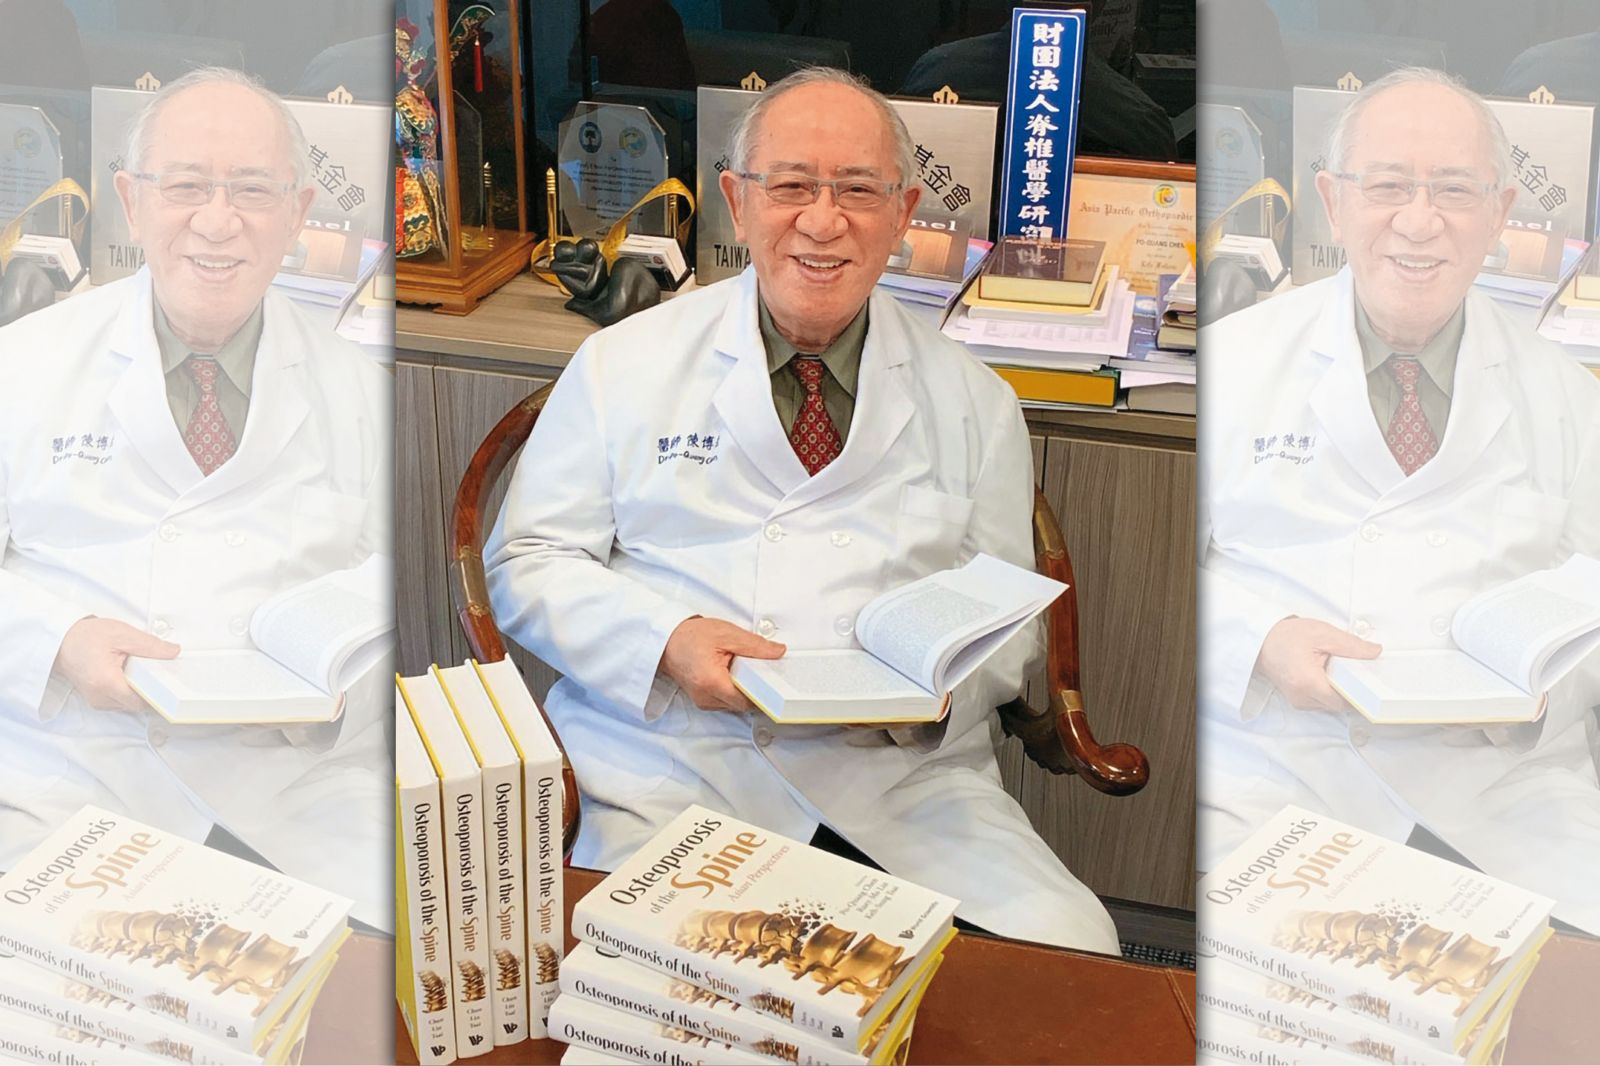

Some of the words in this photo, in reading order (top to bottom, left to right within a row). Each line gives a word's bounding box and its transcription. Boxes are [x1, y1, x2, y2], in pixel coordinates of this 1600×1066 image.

[1079, 202, 1100, 213] Asia
[1104, 204, 1135, 217] Pacific
[455, 793, 475, 877] Osteoporosis
[493, 782, 512, 866] Osteoporosis
[535, 776, 554, 860] Osteoporosis
[3, 818, 116, 905] Osteoporosis
[412, 803, 434, 887] Osteoporosis
[609, 818, 722, 905] Osteoporosis
[1205, 818, 1318, 905] Osteoporosis
[51, 890, 74, 906] the
[64, 831, 162, 899] Spine
[498, 868, 515, 881] of
[539, 862, 555, 874] of
[670, 831, 768, 899] Spine
[1253, 890, 1276, 906] the
[1266, 831, 1364, 899] Spine
[420, 889, 437, 902] of
[461, 879, 478, 892] of
[499, 882, 515, 904] the
[539, 876, 555, 898] the
[657, 890, 680, 906] the
[421, 903, 438, 926] the
[462, 894, 478, 916] the
[496, 905, 516, 941] Spine
[536, 898, 555, 934] Spine
[650, 900, 665, 915] of
[419, 926, 439, 963] Spine
[460, 916, 479, 952] Spine
[59, 958, 72, 972] of
[75, 963, 95, 981] the
[98, 971, 134, 996] Spine
[585, 922, 663, 967] Osteoporosis
[665, 958, 678, 972] of
[681, 963, 701, 981] the
[704, 971, 740, 996] Spine
[1261, 958, 1274, 972] of
[1277, 963, 1297, 981] the
[1300, 971, 1336, 996] Spine
[55, 1010, 69, 1023] of
[72, 1015, 94, 1030] the
[97, 1020, 135, 1043] Spine
[575, 980, 659, 1018] Osteoporosis
[661, 1010, 675, 1023] of
[678, 1015, 700, 1030] the
[703, 1020, 741, 1043] Spine
[1257, 1010, 1271, 1023] of
[1274, 1015, 1296, 1030] the
[1299, 1020, 1337, 1043] Spine
[47, 1050, 62, 1064] of
[564, 1023, 651, 1059] Osteoporosis
[653, 1050, 668, 1064] of
[1249, 1050, 1264, 1064] of
